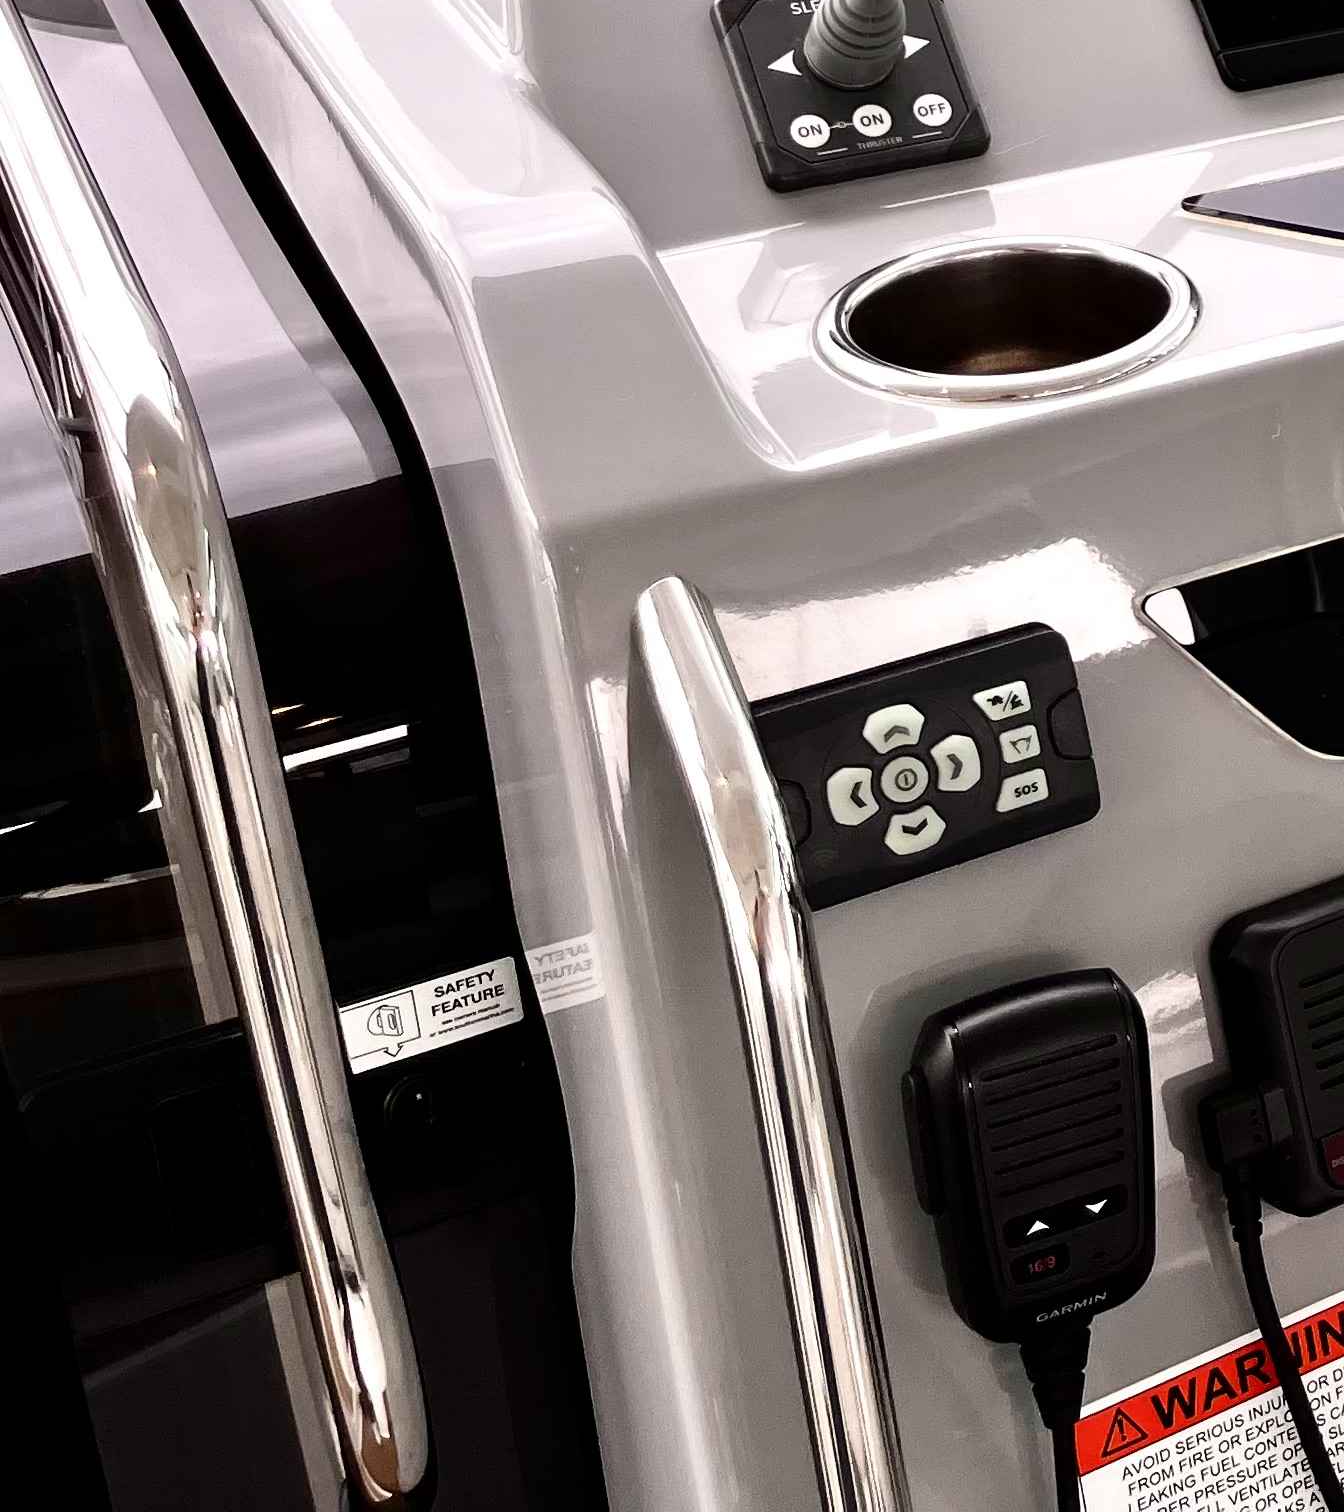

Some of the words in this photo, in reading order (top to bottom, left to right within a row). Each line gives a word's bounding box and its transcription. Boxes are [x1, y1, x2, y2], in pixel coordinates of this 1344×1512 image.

[860, 113, 885, 127] ON
[917, 102, 947, 118] OFF
[798, 123, 823, 138] ON
[856, 136, 903, 150] THRUSTER
[1014, 781, 1039, 798] SOS
[433, 968, 495, 998] SAFETY
[431, 984, 505, 1017] FEATURE
[1036, 1291, 1107, 1323] GARMIN
[1122, 1448, 1171, 1481] AVOID
[1175, 1413, 1244, 1455] SERIOUS
[1249, 1392, 1289, 1417] INJU
[1306, 1374, 1330, 1394] OR
[1128, 1465, 1175, 1496] FROM
[1178, 1447, 1215, 1472] FIRE
[1218, 1435, 1242, 1454] OR
[1245, 1393, 1332, 1443] EXPLOON
[1200, 1454, 1241, 1482] FUEL
[1243, 1413, 1326, 1461] CONTES
[1194, 1454, 1278, 1505] PRESSURE
[1228, 1457, 1312, 1506] VENTILATE
[1255, 1492, 1279, 1512] OR
[1282, 1477, 1318, 1499] OPE
